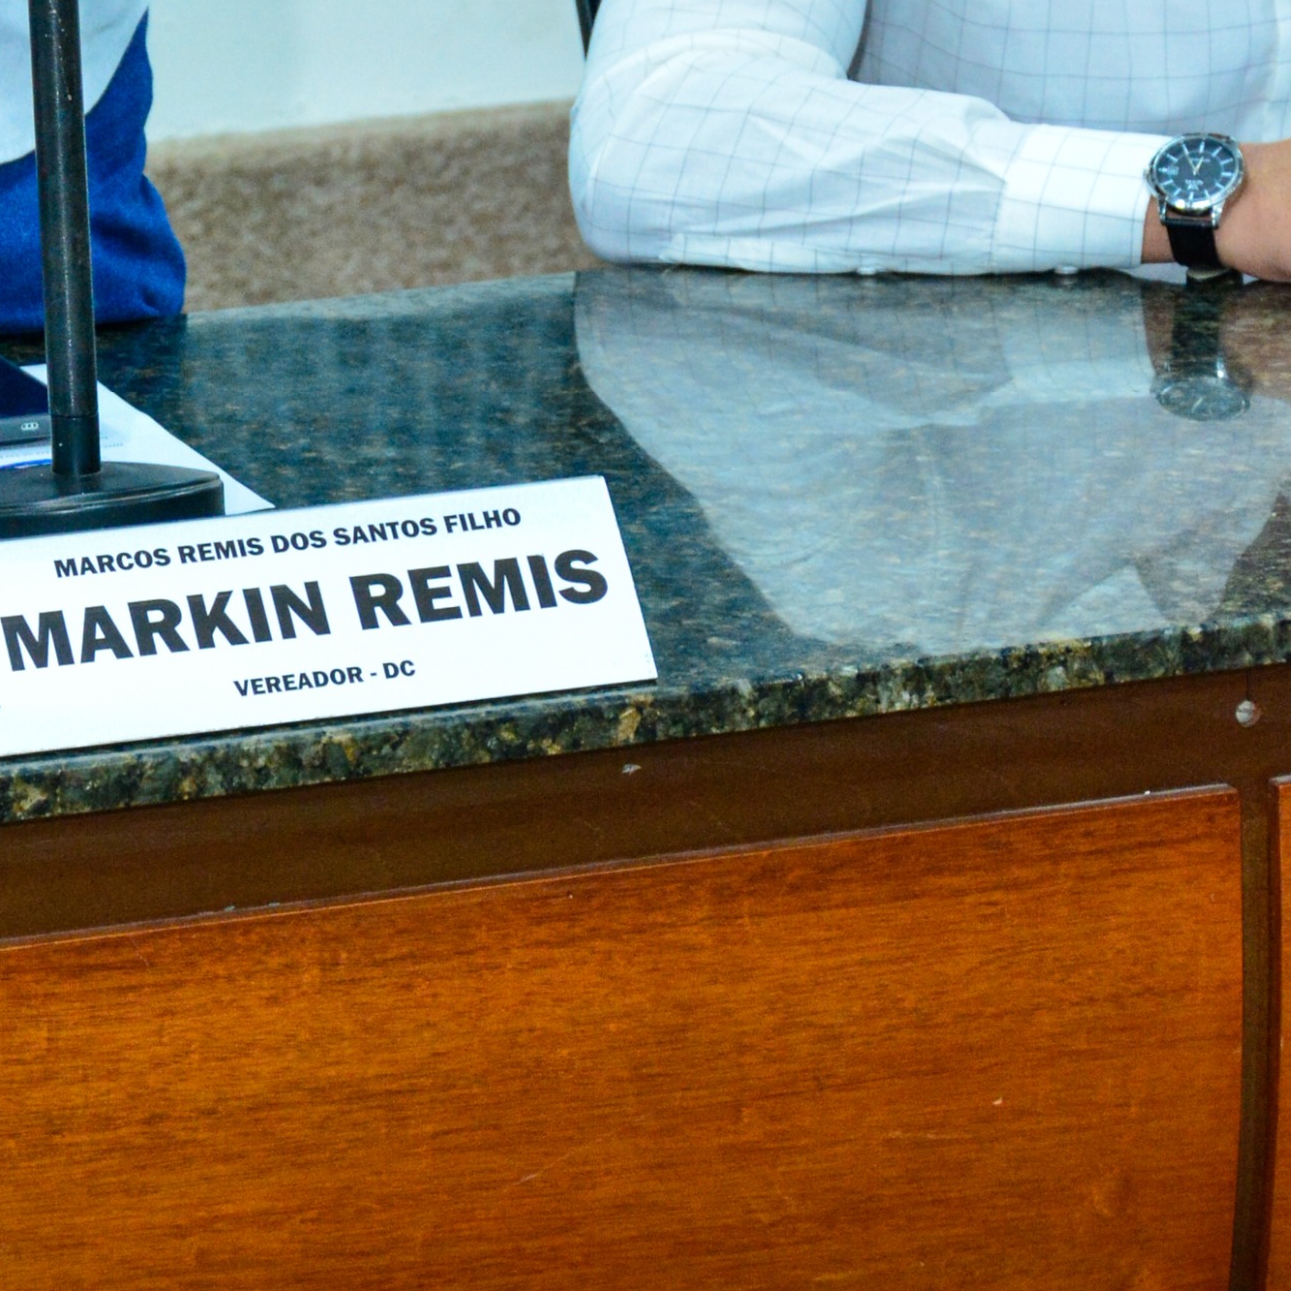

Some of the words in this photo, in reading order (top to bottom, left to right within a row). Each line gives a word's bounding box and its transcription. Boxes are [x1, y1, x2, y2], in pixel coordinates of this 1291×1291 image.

[54, 547, 172, 579] MARCOS
[177, 537, 265, 565] REMIS
[271, 529, 328, 555] DOS
[333, 517, 439, 547] SANTOS
[444, 507, 522, 534] FILHO
[0, 580, 332, 673] MARKIN
[347, 548, 609, 632] REMIS
[233, 664, 365, 698] VEREADOR
[382, 659, 417, 680] DC
